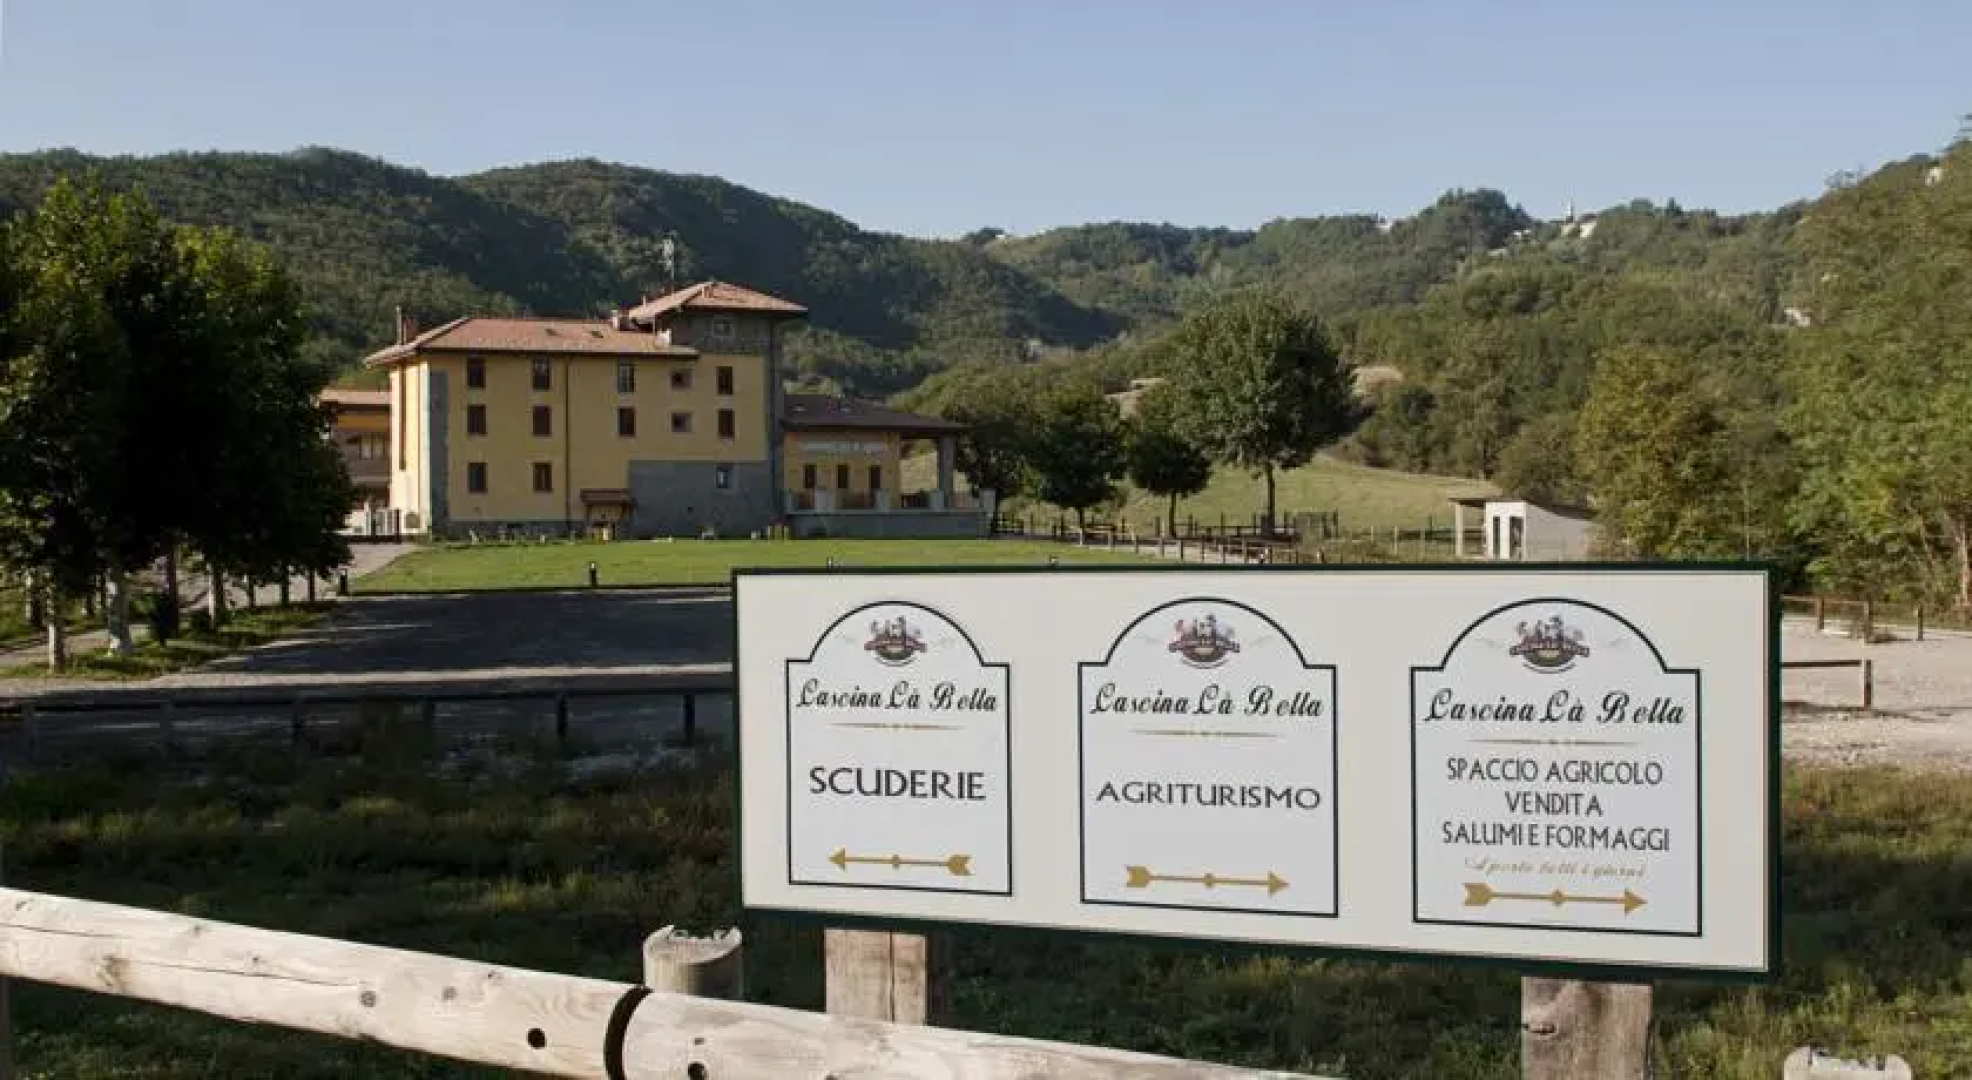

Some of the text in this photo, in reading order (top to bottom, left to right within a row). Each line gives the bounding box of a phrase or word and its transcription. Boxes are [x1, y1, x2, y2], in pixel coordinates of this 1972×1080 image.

[929, 682, 997, 712] Bella
[1244, 685, 1323, 717] Bella
[1596, 691, 1685, 724] Bella
[809, 766, 987, 801] SCUDERIE
[1447, 757, 1663, 785] SPACCIO AGRICOLO
[1096, 780, 1322, 810] AGRITURISMO
[1505, 790, 1604, 817] VENDITA
[1442, 821, 1671, 851] SALUMI E FORMAGGI
